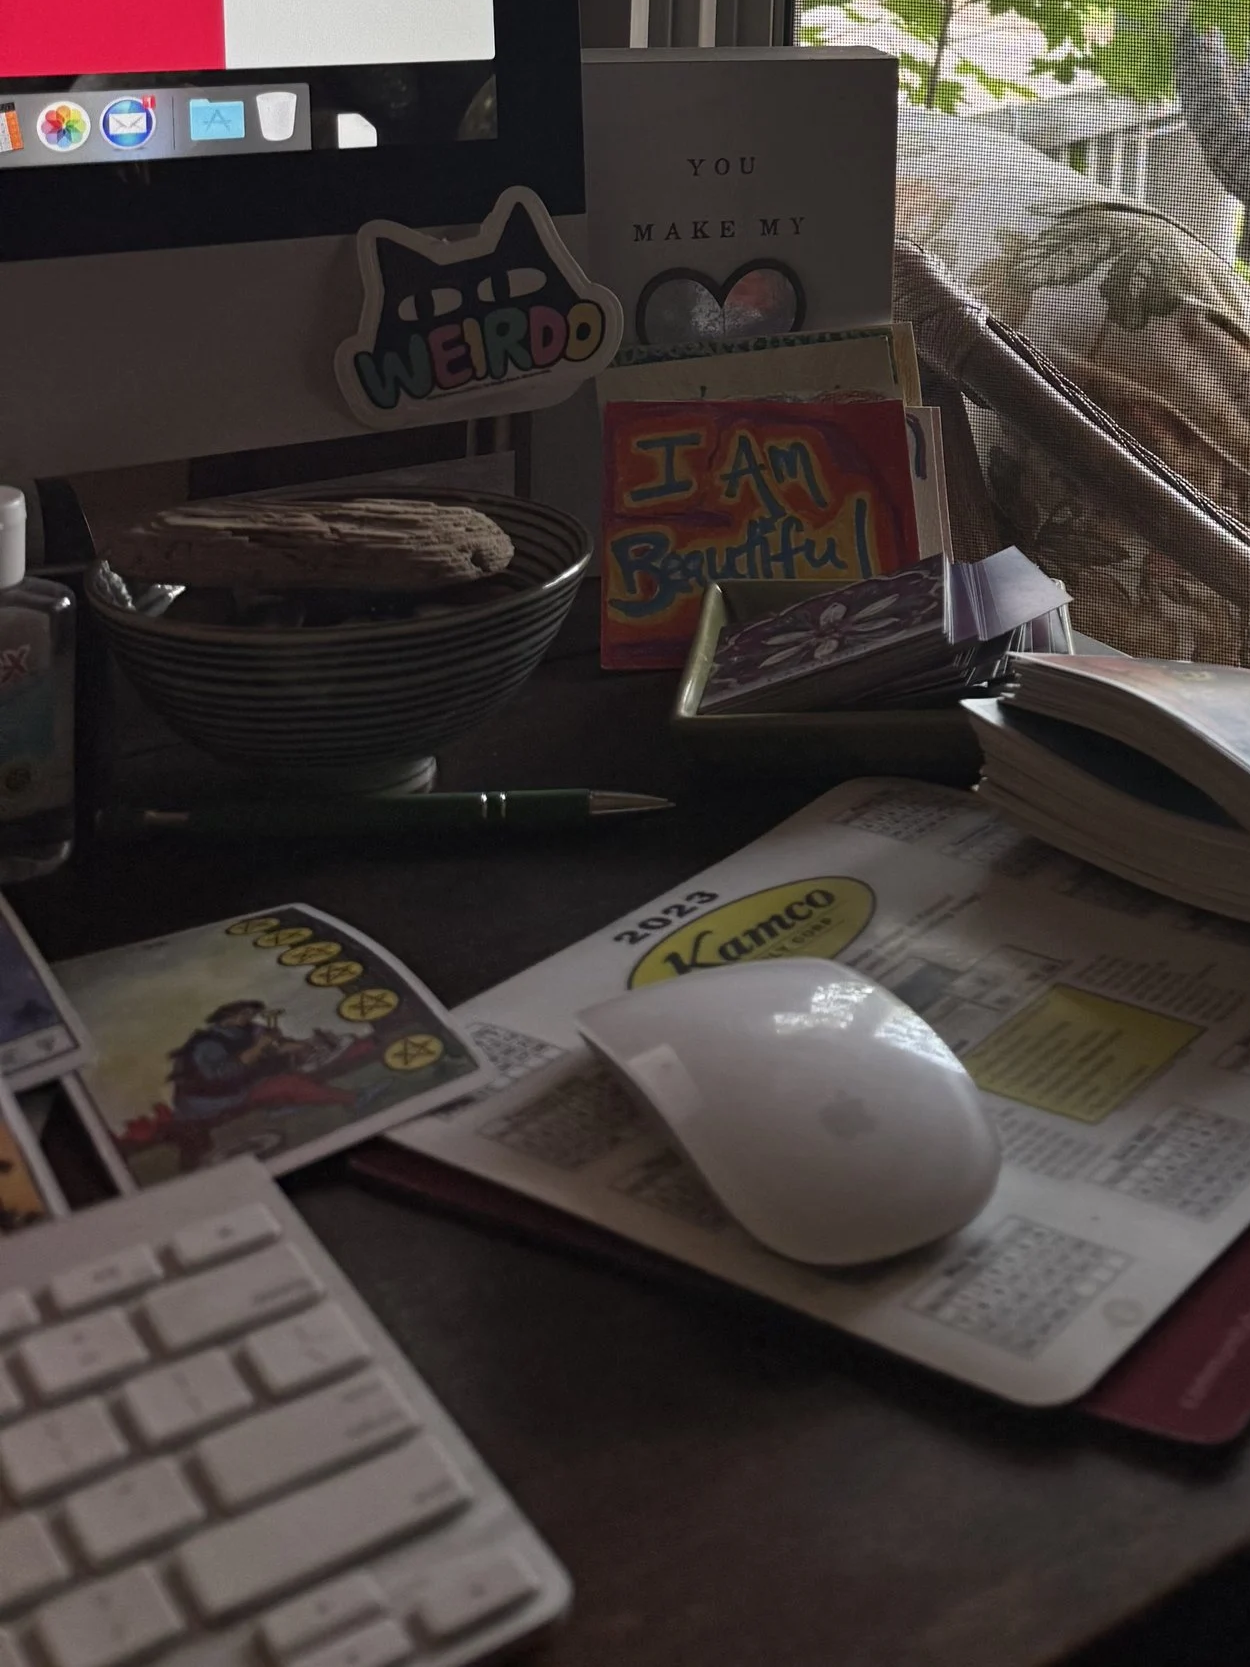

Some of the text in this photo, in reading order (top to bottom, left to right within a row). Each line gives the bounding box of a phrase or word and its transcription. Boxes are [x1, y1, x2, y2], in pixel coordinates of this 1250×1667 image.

[686, 156, 757, 178] YOU
[632, 215, 808, 243] MAKE MY
[353, 297, 606, 410] WEIRDO
[629, 432, 701, 502] I
[608, 498, 874, 618] Beautiful
[613, 889, 719, 945] 2023
[663, 888, 836, 976] Kamco
